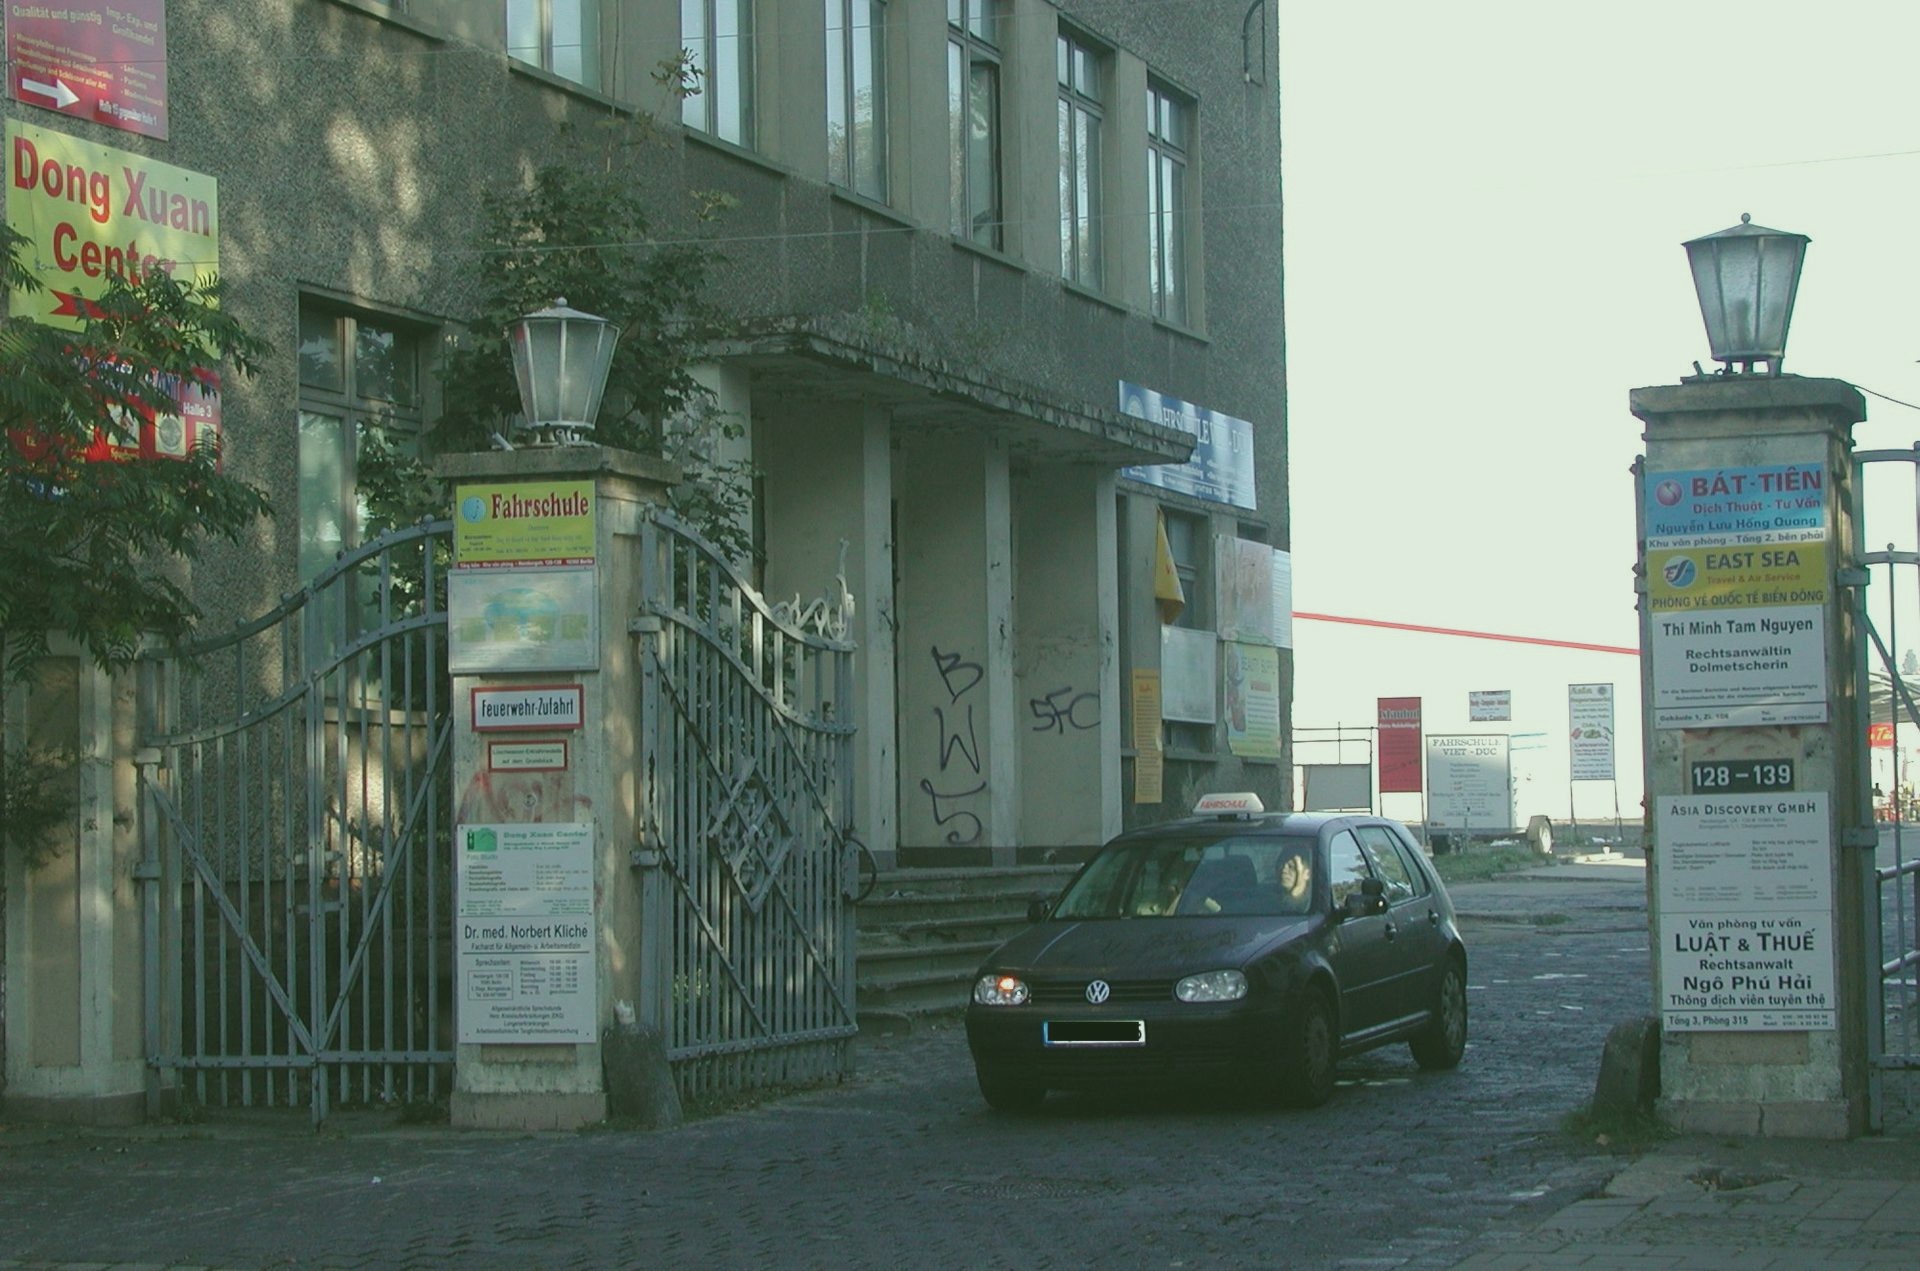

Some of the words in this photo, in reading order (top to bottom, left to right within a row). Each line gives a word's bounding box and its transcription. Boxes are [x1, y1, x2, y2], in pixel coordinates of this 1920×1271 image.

[14, 136, 110, 224] Dong
[122, 166, 210, 237] Xuan
[183, 402, 206, 416] Halle
[206, 405, 213, 418] 3
[491, 490, 589, 520] Fahrschule
[1774, 515, 1817, 530] Quang
[1706, 552, 1755, 570] EAST
[1762, 550, 1800, 567] SEA
[1707, 576, 1736, 584] Travel
[1749, 574, 1762, 583] Air
[1765, 573, 1801, 583] Service
[1663, 623, 1685, 637] Thi
[1689, 621, 1722, 636] Minh
[1726, 619, 1756, 633] Tam
[1761, 618, 1814, 636] Nguyen
[1686, 646, 1792, 660] Rechtsanwältin
[1689, 660, 1789, 673] Dolmetscherin
[482, 697, 574, 718] Feuerwehr-Zufahrt
[1433, 738, 1502, 747] FAHRSCHULE
[1694, 766, 1730, 787] 128
[1753, 764, 1791, 785] 139
[1670, 805, 1700, 816] ASIA
[1704, 803, 1775, 815] DISCOVERY
[465, 924, 480, 939] Dr.
[482, 925, 508, 939] med.
[511, 924, 551, 939] Norbert
[1737, 938, 1750, 951] &
[1700, 958, 1794, 970] Rechtsanwalt
[1683, 976, 1724, 993] Ngô
[1732, 975, 1770, 990] Phú
[1732, 1015, 1749, 1025] 315
